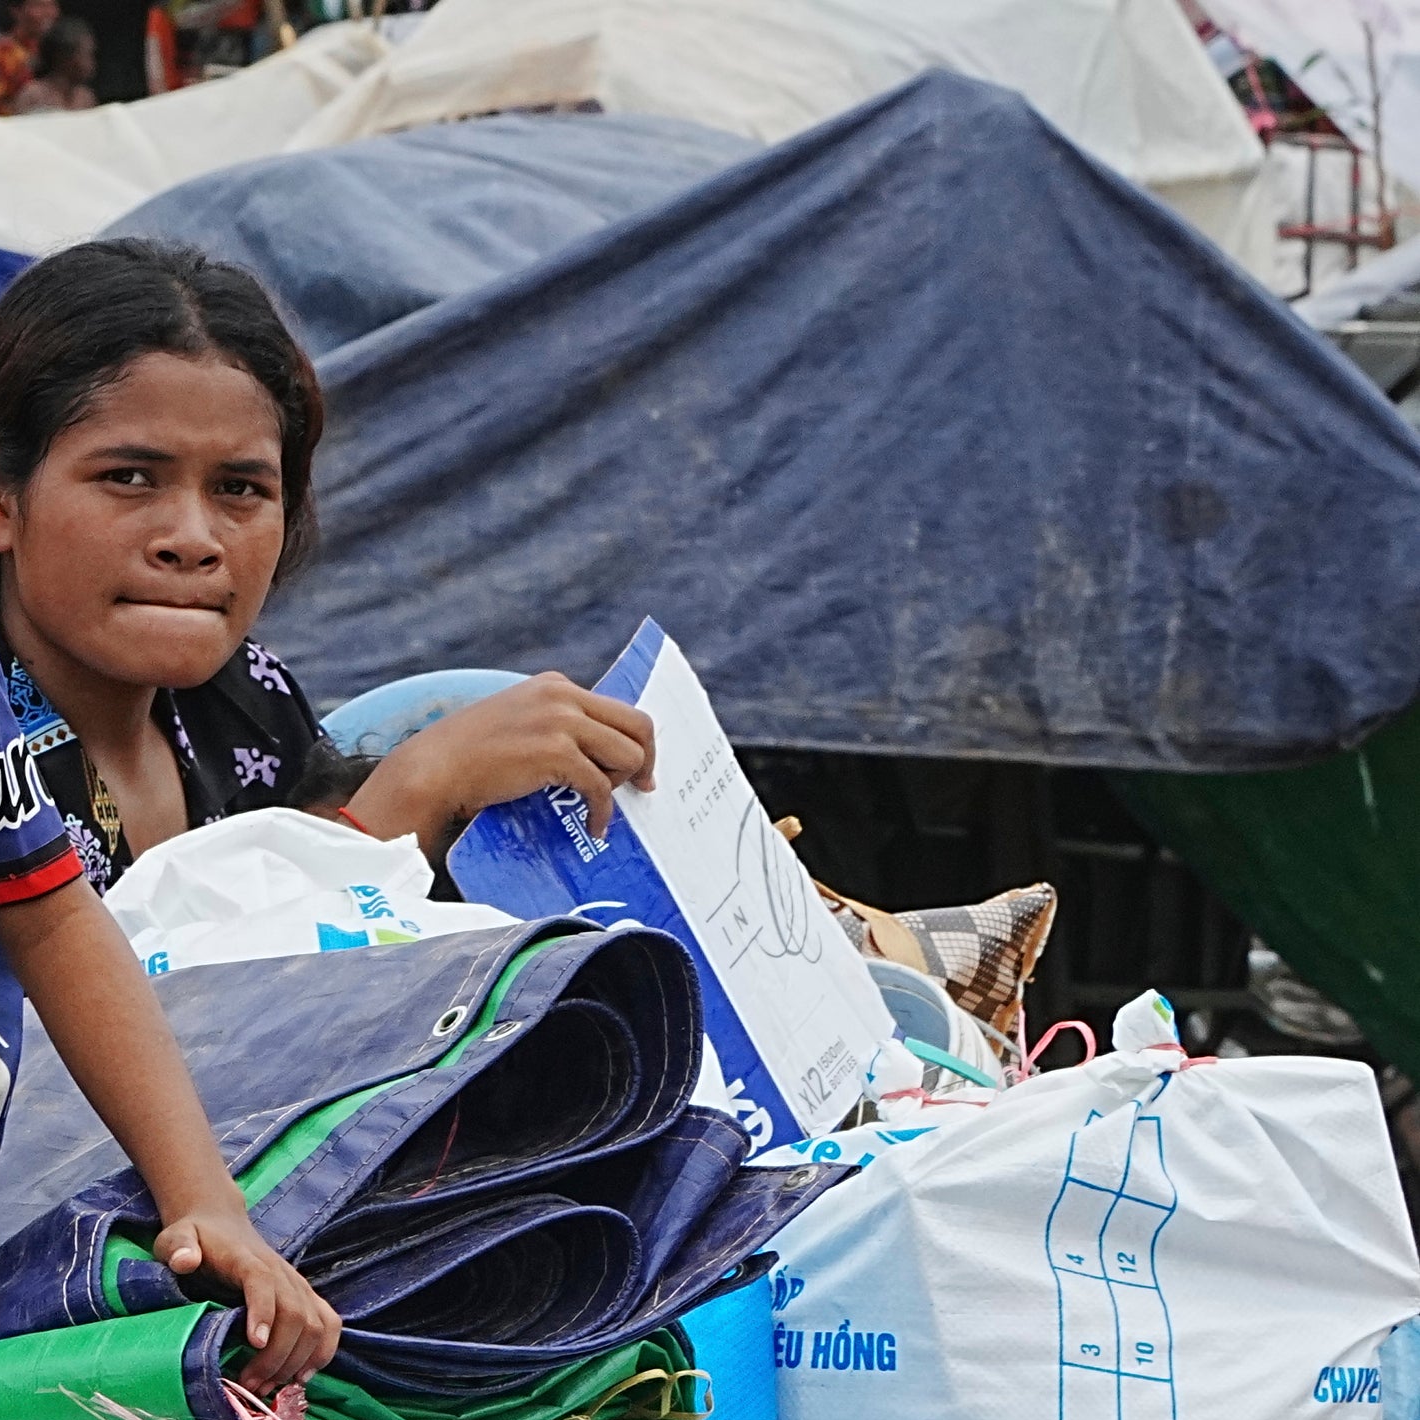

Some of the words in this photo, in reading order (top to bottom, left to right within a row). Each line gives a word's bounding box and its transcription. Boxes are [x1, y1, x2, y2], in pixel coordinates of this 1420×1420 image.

[687, 760, 739, 833] FILTERED
[560, 814, 594, 864] BOTTLES
[721, 905, 750, 946] IN
[830, 1055, 858, 1092] BOTTLES
[1066, 1253, 1085, 1266] 4
[1117, 1252, 1137, 1274] 12
[1080, 1343, 1102, 1357] 3
[1135, 1341, 1155, 1366] 10
